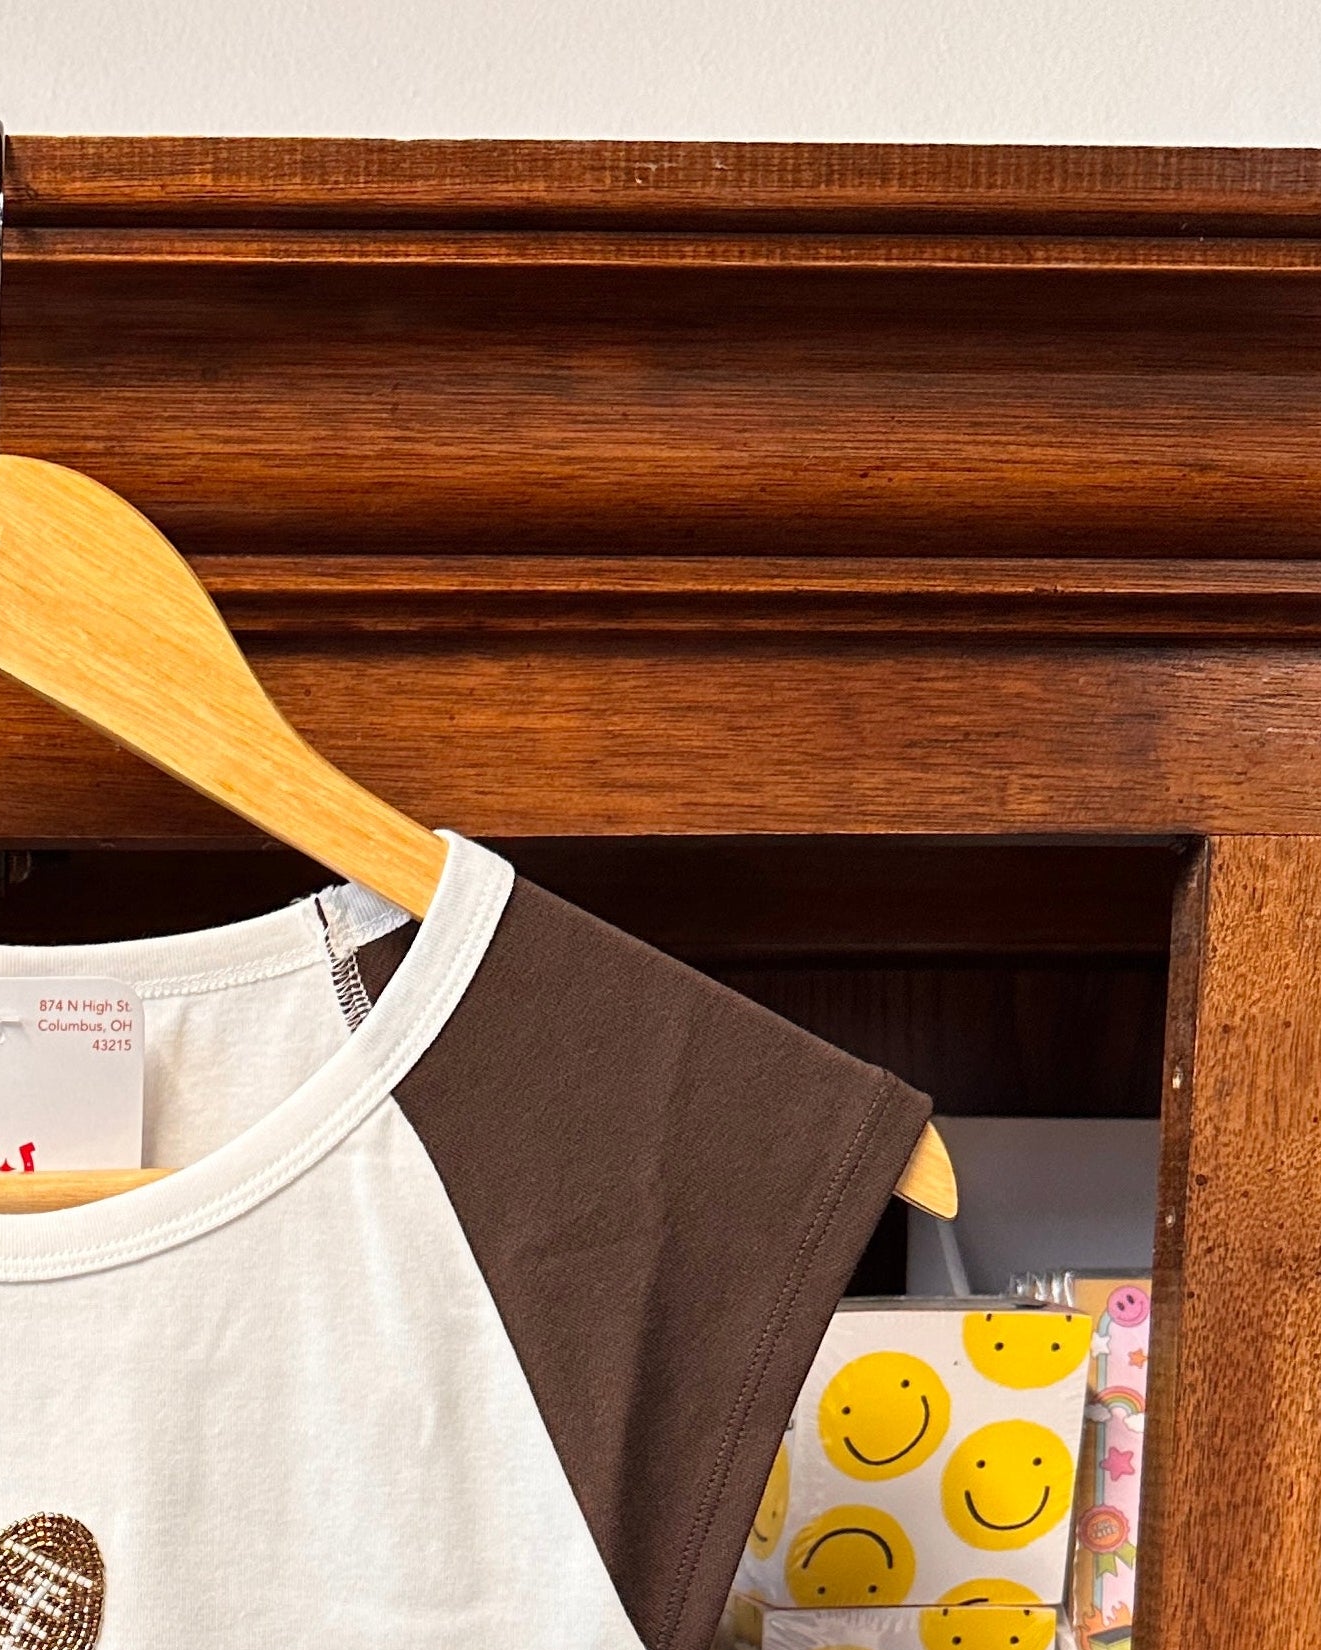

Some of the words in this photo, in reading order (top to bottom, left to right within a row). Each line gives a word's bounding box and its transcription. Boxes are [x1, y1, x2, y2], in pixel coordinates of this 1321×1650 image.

[39, 999, 63, 1012] 874
[67, 1000, 78, 1012] N
[82, 999, 113, 1015] High
[37, 1018, 107, 1033] Columbus,
[110, 1019, 133, 1032] OH
[92, 1039, 132, 1052] 43215
